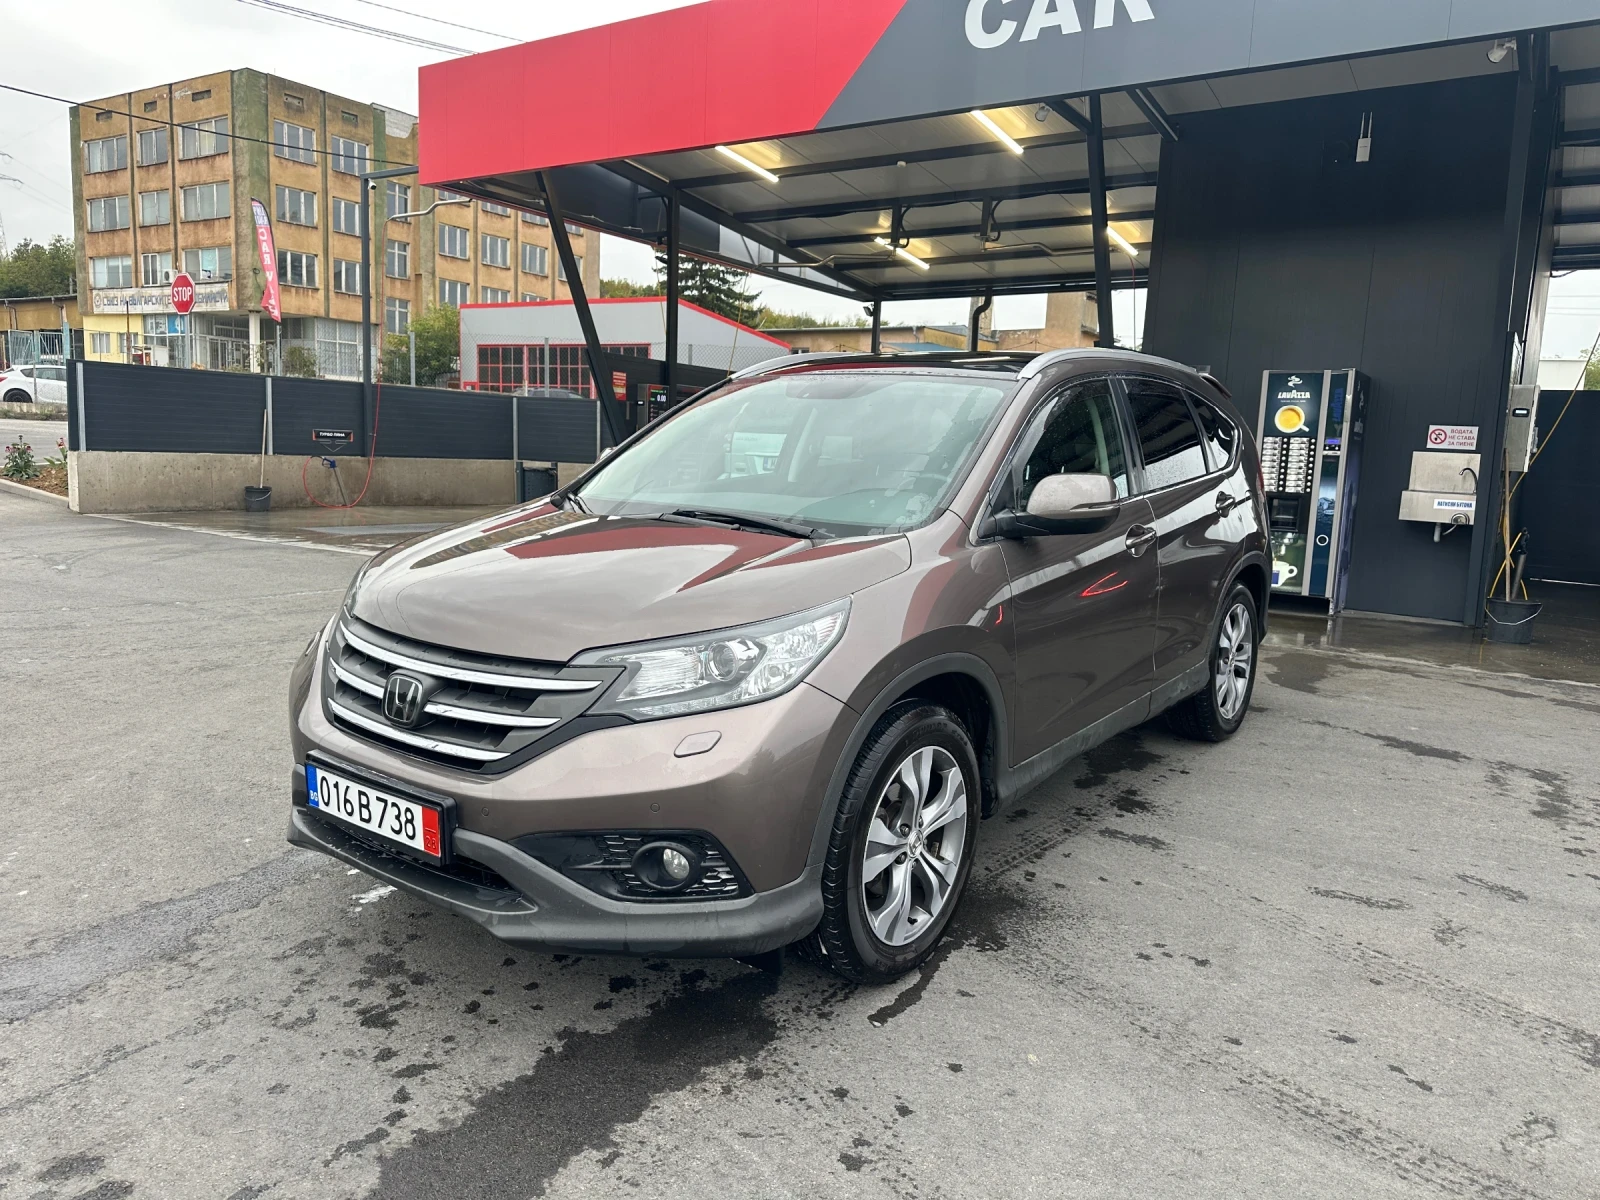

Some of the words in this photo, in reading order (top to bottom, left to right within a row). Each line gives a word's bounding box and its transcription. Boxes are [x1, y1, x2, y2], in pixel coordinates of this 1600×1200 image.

[173, 287, 192, 302] STOP
[1277, 389, 1310, 399] LAVAZZA
[309, 789, 318, 802] BG
[320, 775, 416, 841] 016B738
